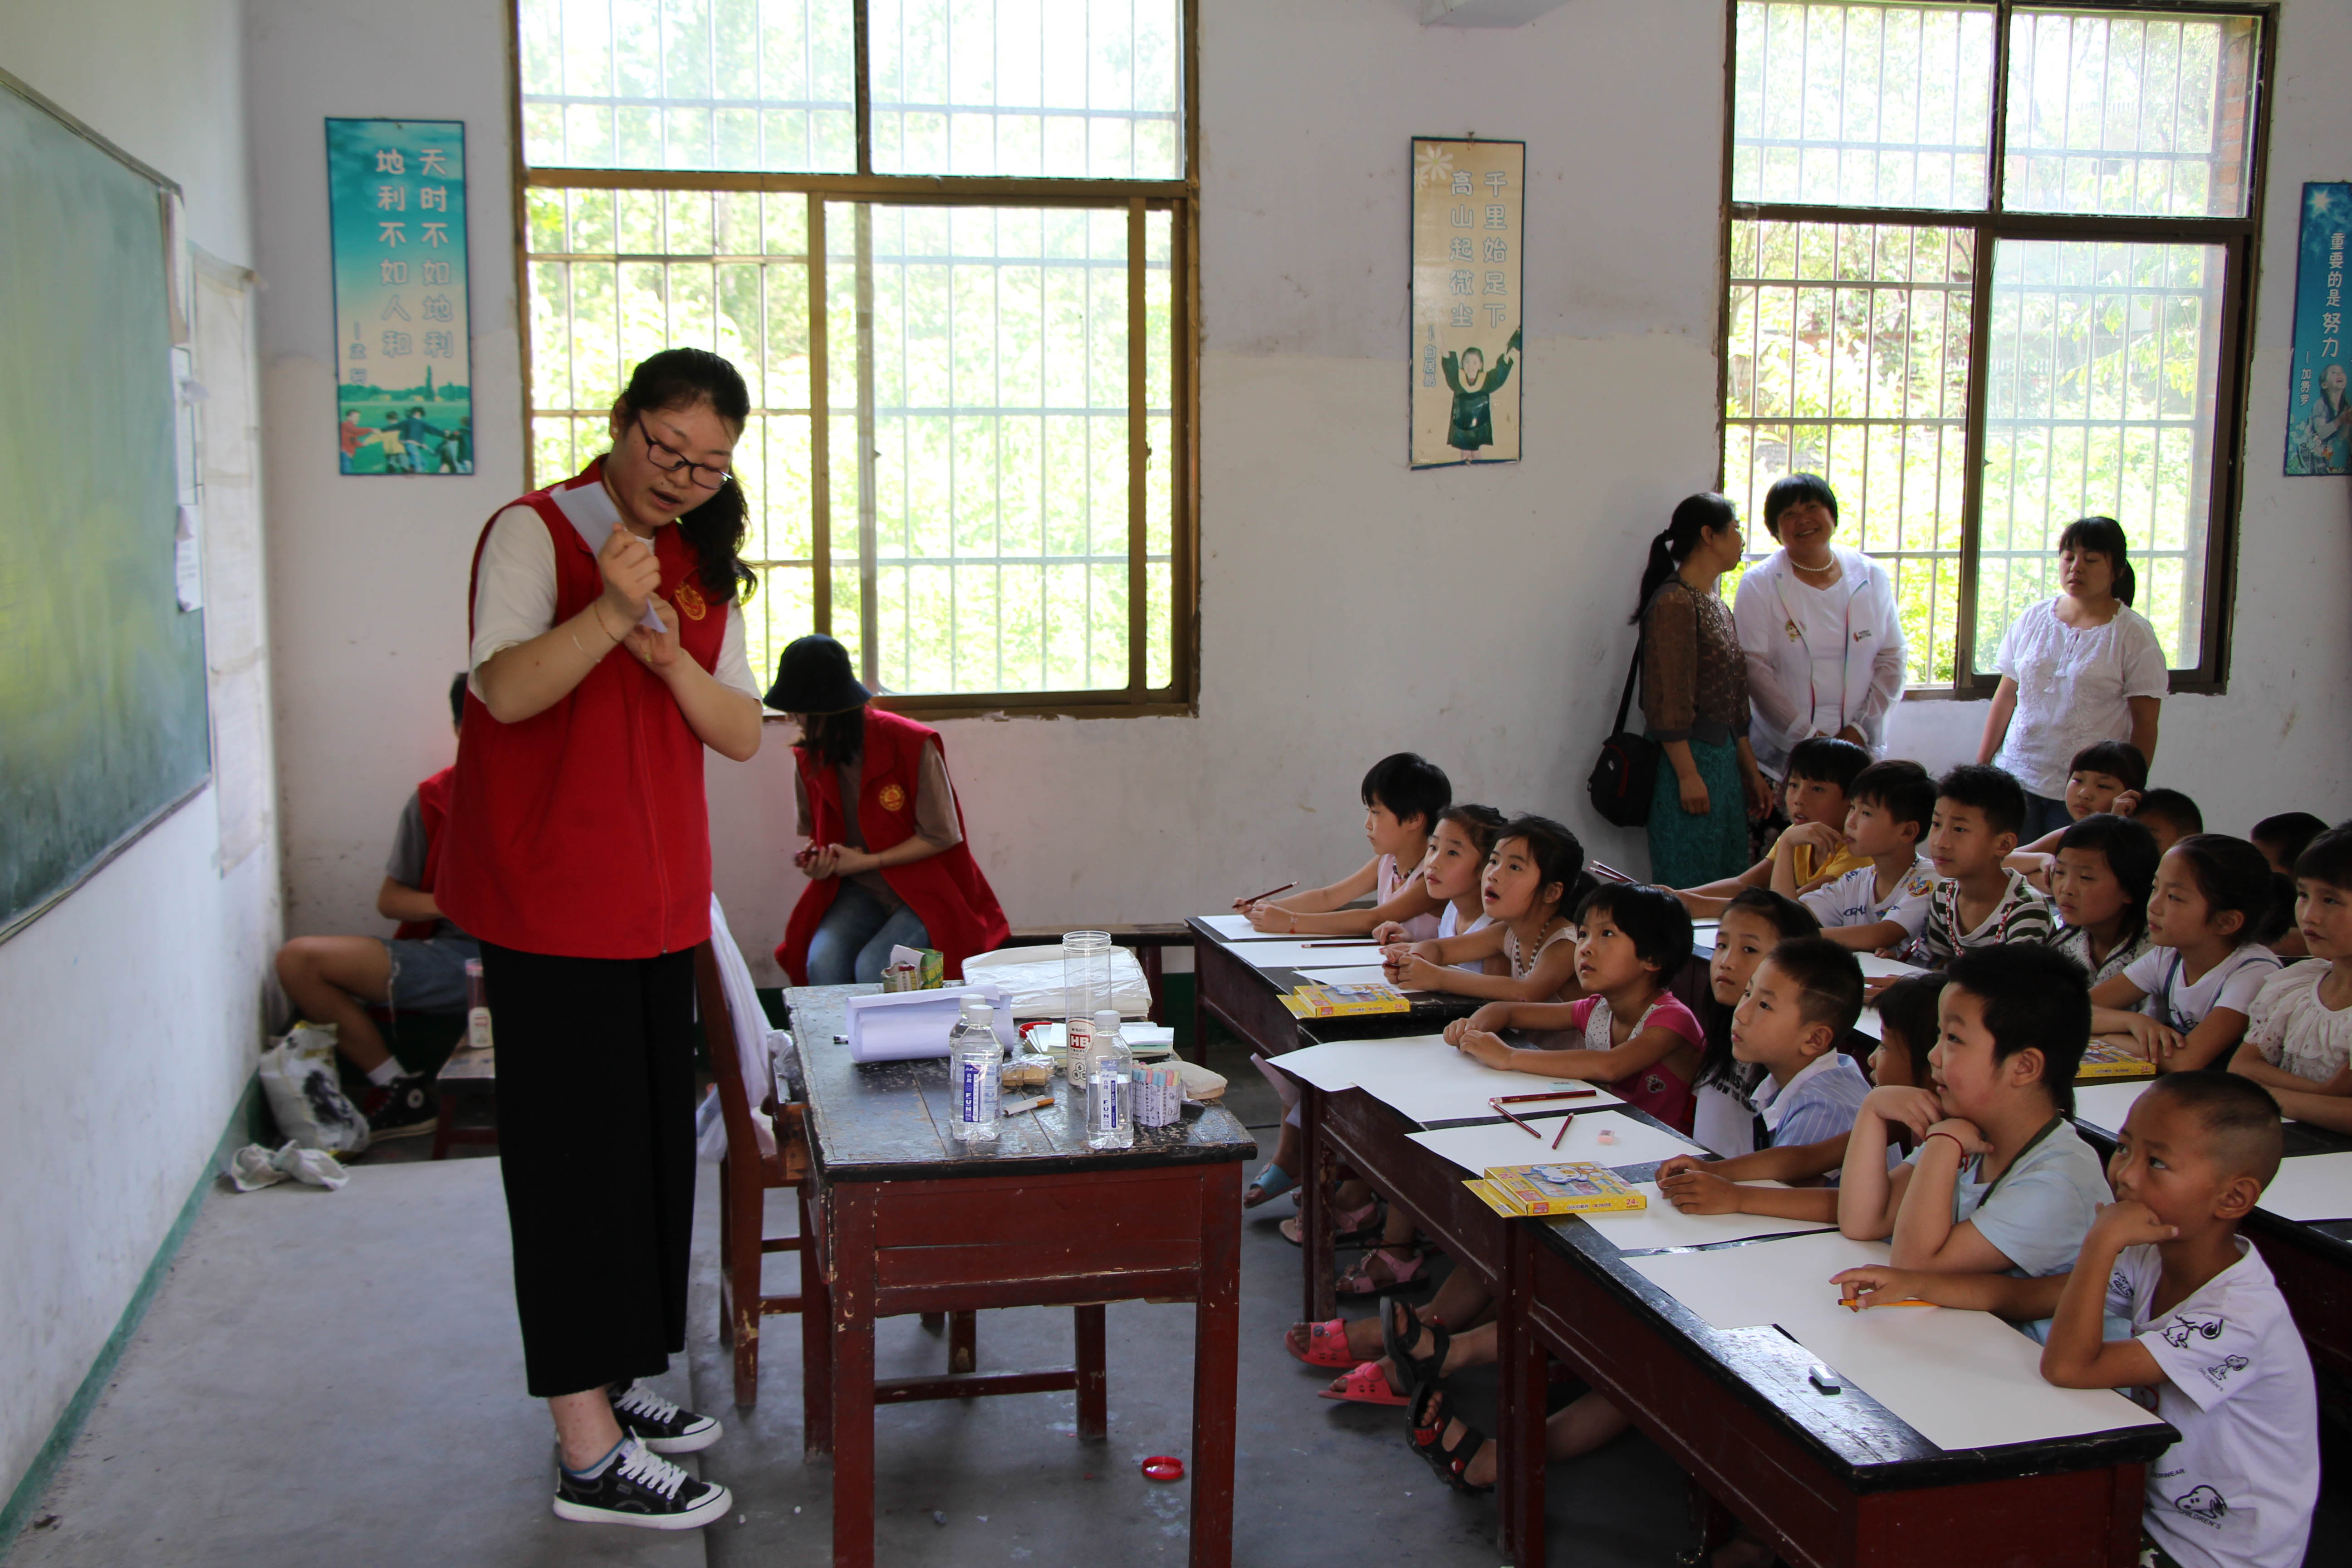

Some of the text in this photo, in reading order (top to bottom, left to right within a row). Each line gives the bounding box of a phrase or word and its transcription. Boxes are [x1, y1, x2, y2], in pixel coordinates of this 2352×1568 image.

[375, 148, 411, 357] 地利不如人和
[419, 148, 453, 358] 天时不如地利
[1449, 170, 1474, 328] 高山起微尘
[1483, 171, 1508, 328] 千里始足下
[2321, 232, 2345, 358] 重要的是努力
[1071, 1035, 1089, 1047] HB
[2197, 1367, 2224, 1392] CHILDREN'S
[2178, 1509, 2221, 1529] CHILDREN'S
